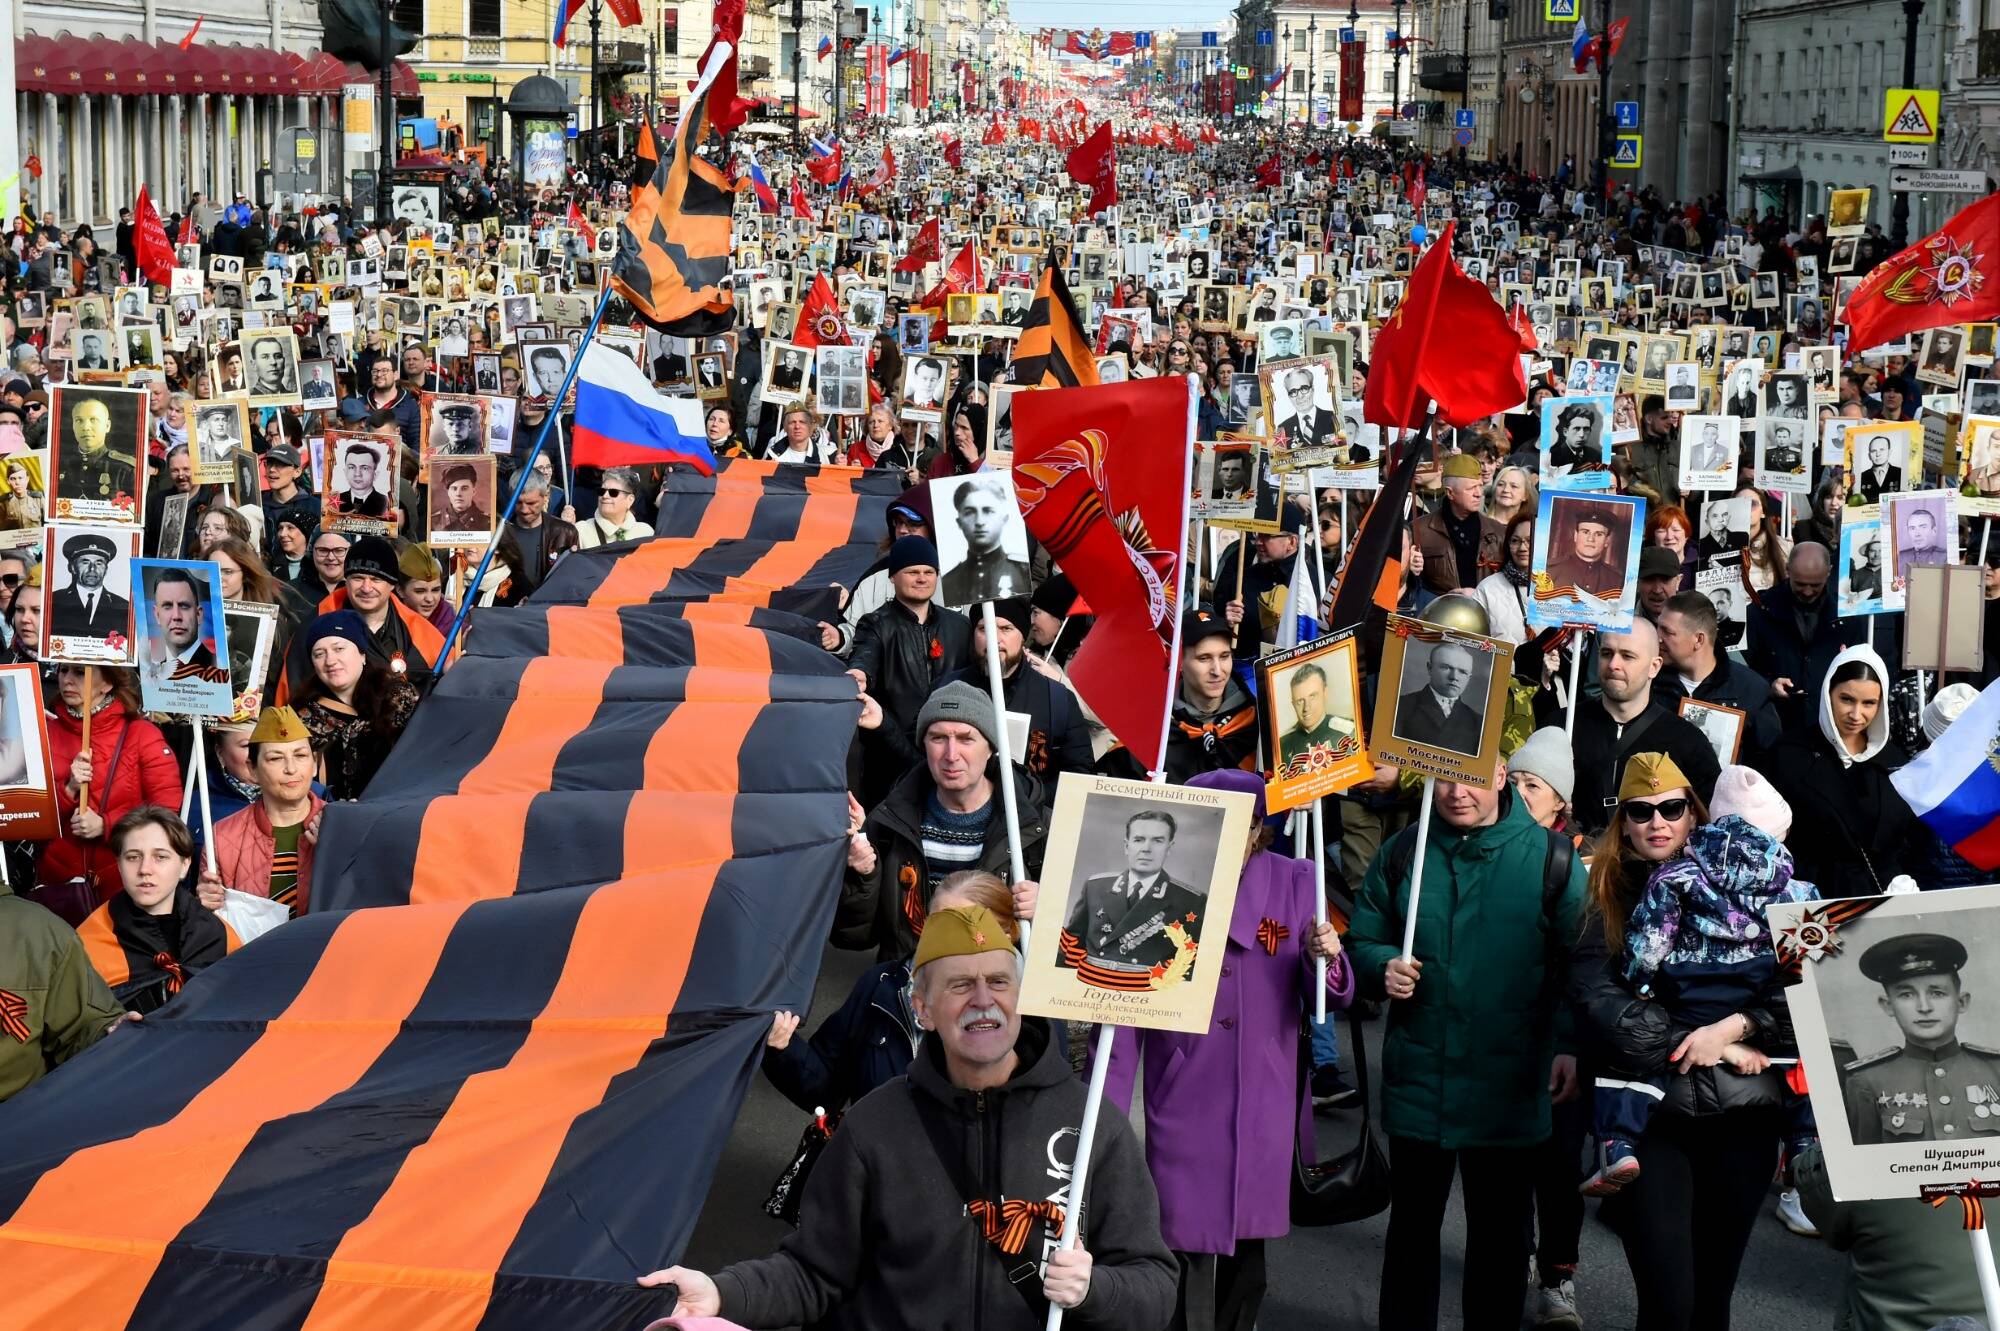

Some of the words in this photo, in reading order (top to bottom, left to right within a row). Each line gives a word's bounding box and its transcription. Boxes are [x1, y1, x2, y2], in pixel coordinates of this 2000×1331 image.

[1920, 172, 1960, 180] БОЛЬШАЯ
[1910, 180, 1968, 189] КОНЮШЕННАЯ
[1264, 652, 1293, 666] КОРЗУН
[1294, 644, 1314, 656] ИВАН
[1315, 629, 1354, 649] МАРКОВИЧ
[1380, 751, 1407, 766] Пётр
[1407, 746, 1461, 766] Москвин
[1095, 780, 1184, 800] Бессмертный
[1188, 793, 1220, 804] полк
[1082, 988, 1150, 1005] Гордеев
[1048, 996, 1102, 1010] Александр
[1104, 1002, 1182, 1018] Александрович
[1091, 1012, 1136, 1024] 1906-1970
[1924, 1148, 1985, 1160] Шушарин
[1890, 1164, 1938, 1173] Степан
